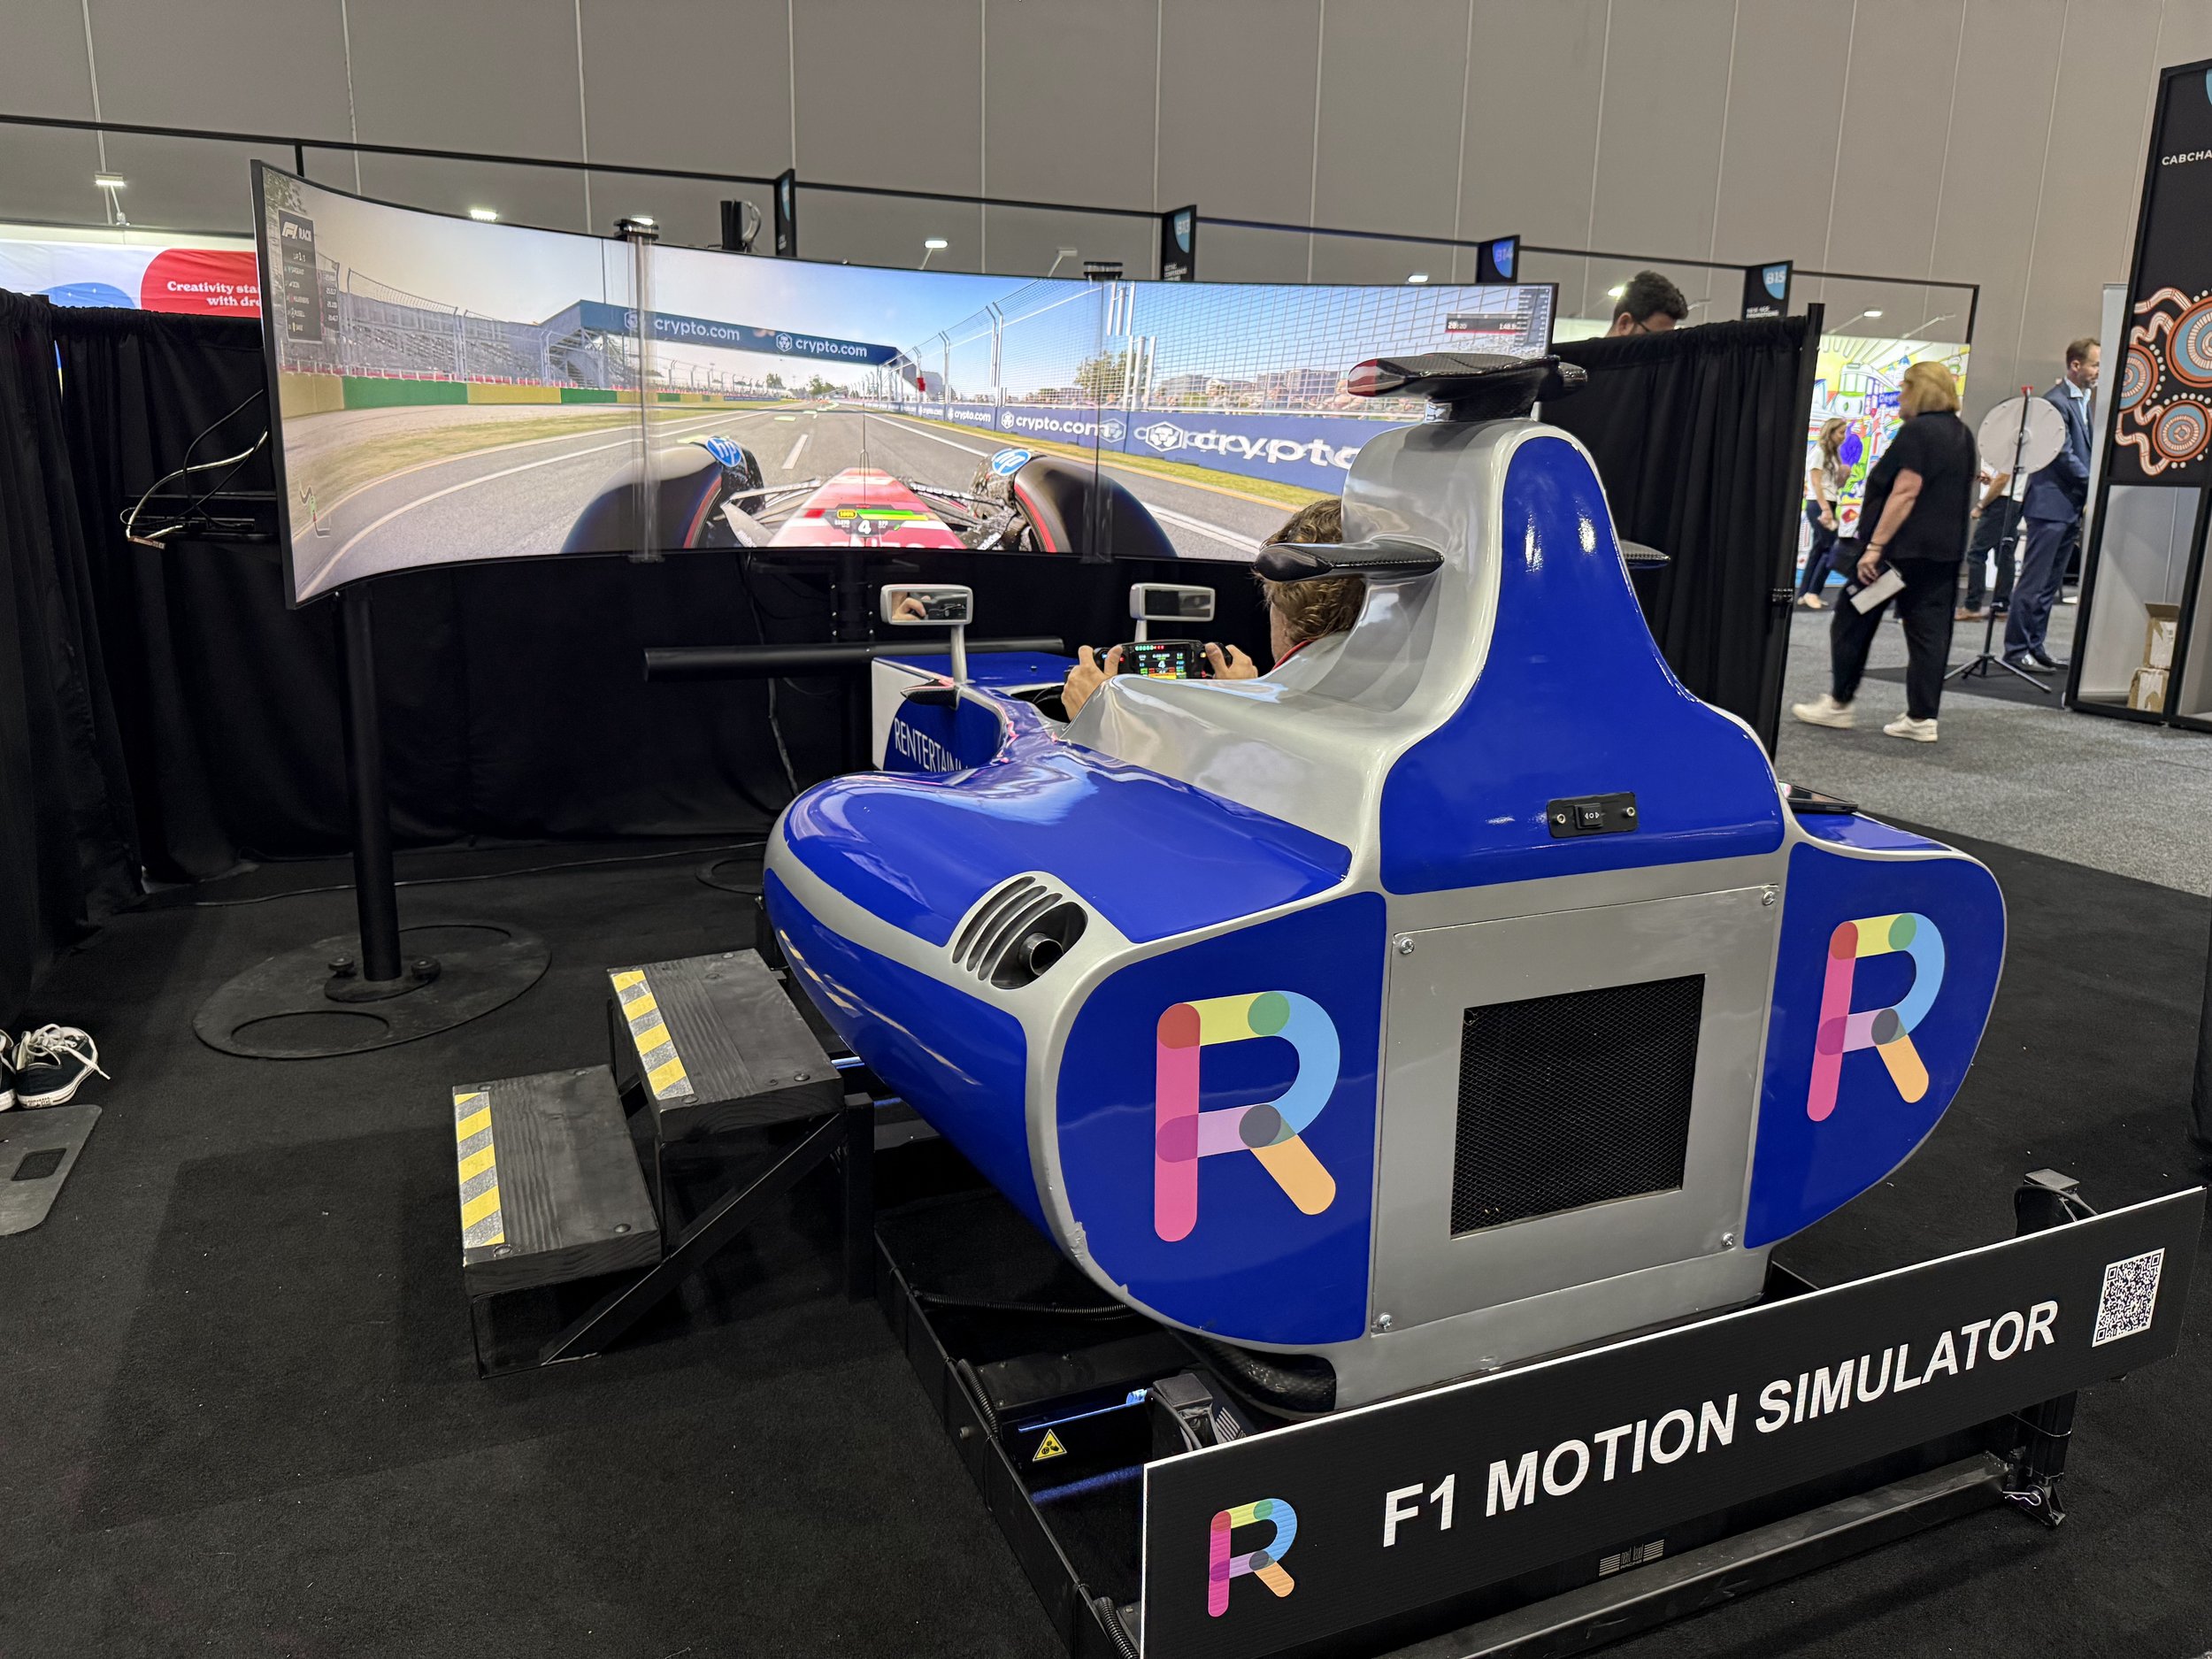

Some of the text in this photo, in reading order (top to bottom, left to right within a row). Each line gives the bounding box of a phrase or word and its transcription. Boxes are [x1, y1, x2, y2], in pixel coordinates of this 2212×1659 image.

[166, 280, 259, 296] Creativity sta
[206, 296, 238, 306] with
[655, 317, 741, 342] crypto.com
[795, 339, 868, 358] crypto.com
[1015, 415, 1111, 438] crypto.com
[858, 519, 872, 534] 4
[1158, 660, 1166, 669] 4
[1383, 1473, 1455, 1548] F1
[1486, 1393, 1739, 1517] MOTION
[1755, 1300, 2059, 1434] SIMULATOR
